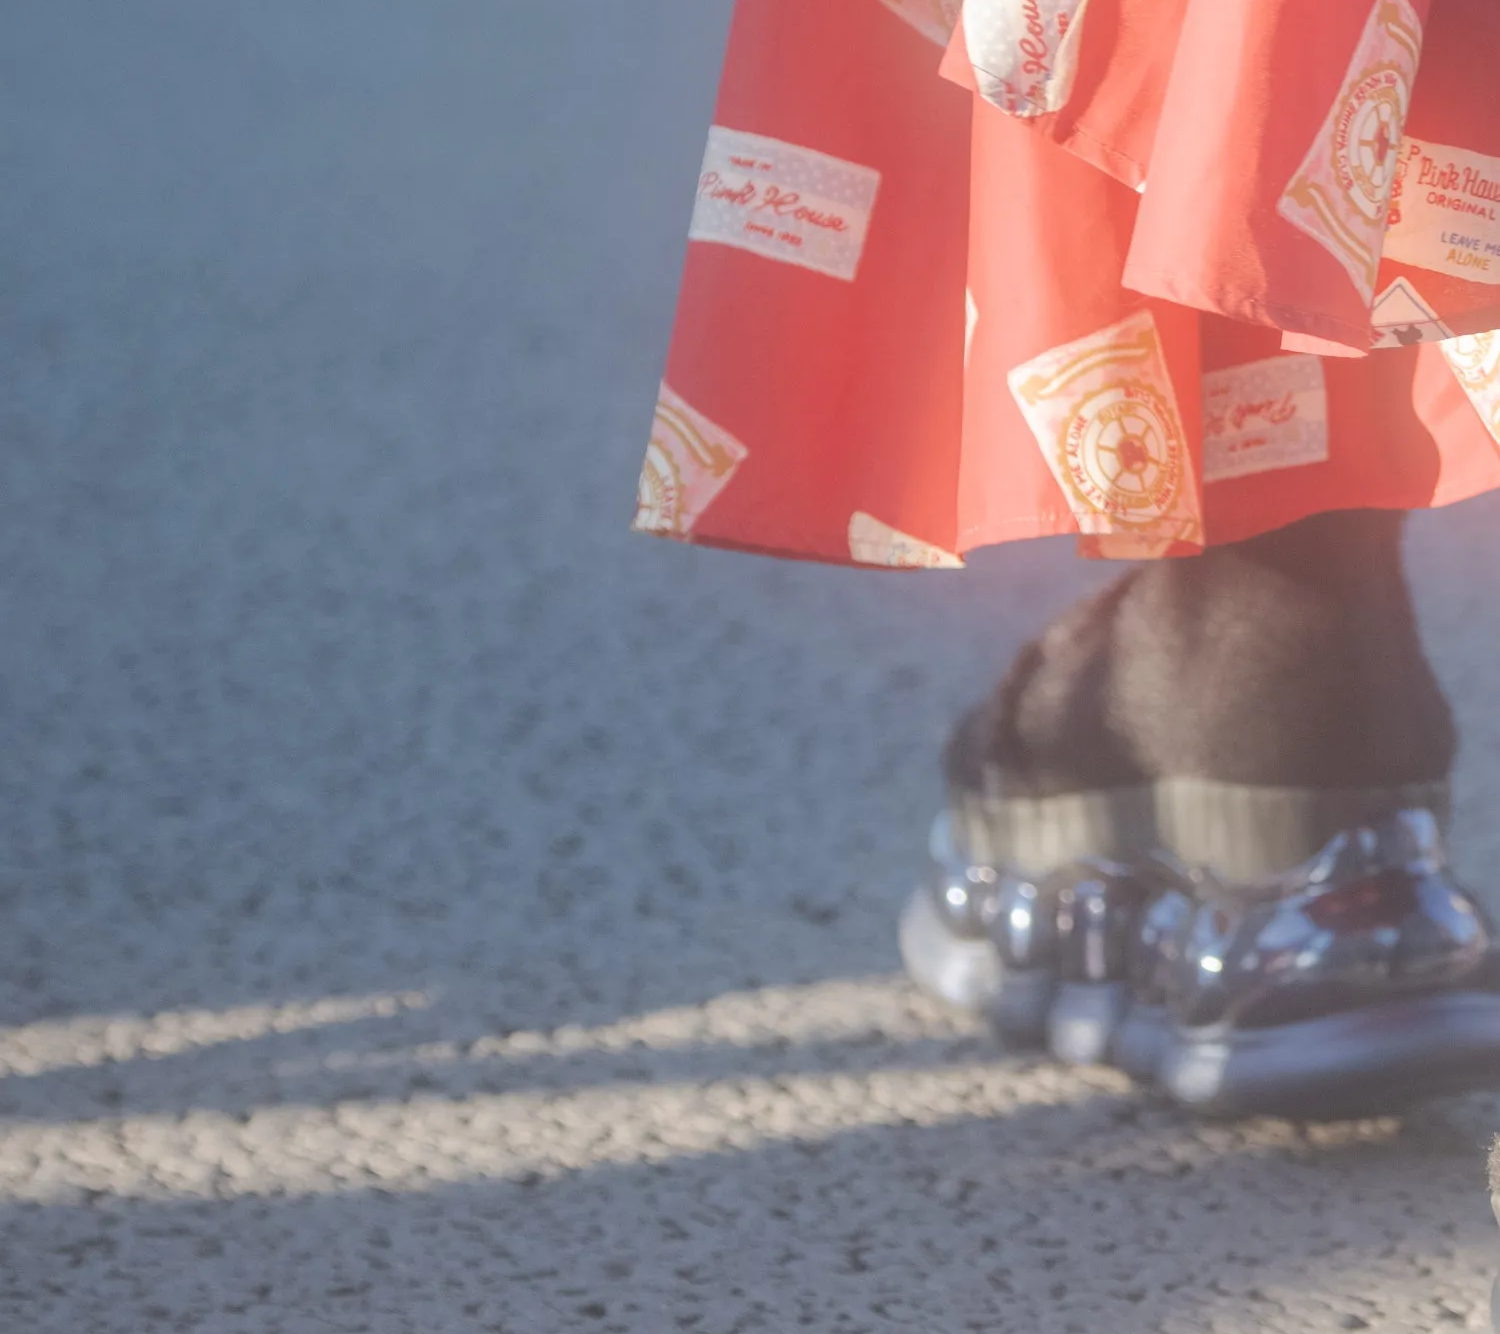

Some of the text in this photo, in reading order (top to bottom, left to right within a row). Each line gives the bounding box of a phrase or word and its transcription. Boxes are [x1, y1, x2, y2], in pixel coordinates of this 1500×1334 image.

[1416, 155, 1461, 192] Pink
[698, 170, 850, 233] Pink House
[1426, 191, 1497, 221] ORIGINAL
[1440, 230, 1482, 251] LEAVE
[1445, 247, 1491, 271] ALONE
[1065, 414, 1089, 458] ALONE
